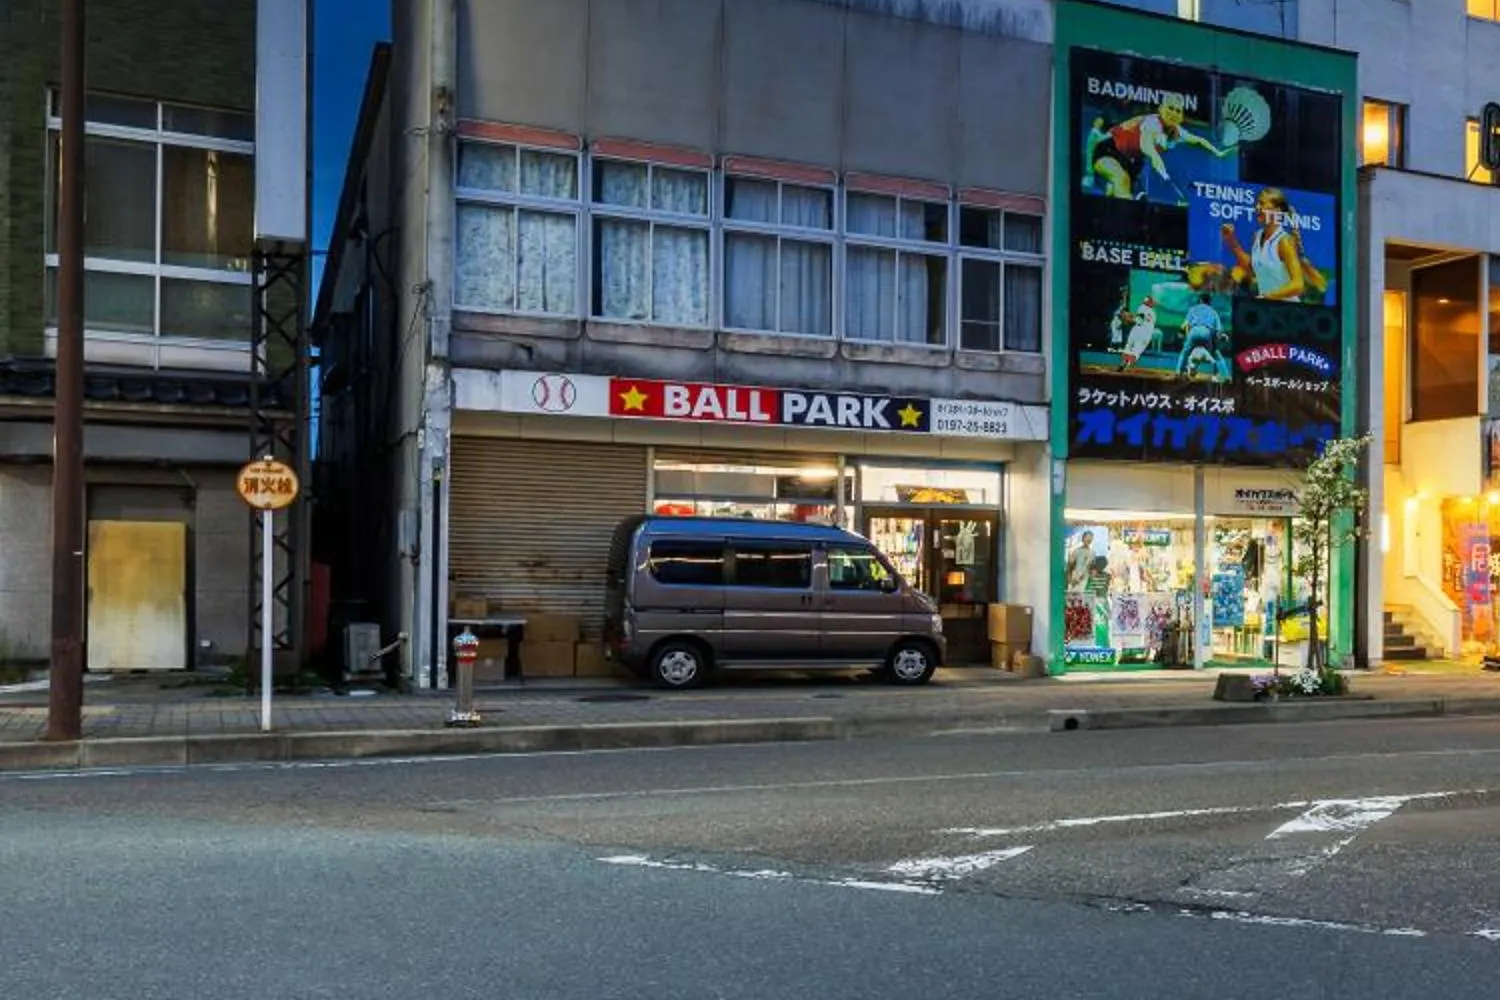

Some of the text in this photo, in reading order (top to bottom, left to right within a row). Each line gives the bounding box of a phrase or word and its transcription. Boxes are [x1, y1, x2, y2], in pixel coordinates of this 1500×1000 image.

[1088, 77, 1198, 112] BADMINTON
[1193, 181, 1256, 203] TENNIS
[1210, 201, 1321, 231] SOFT TENNIS
[1081, 241, 1187, 272] BASE BALL
[1251, 346, 1326, 370] BALL PARK
[664, 385, 891, 428] BALL PARK
[243, 476, 293, 494] 消火栓
